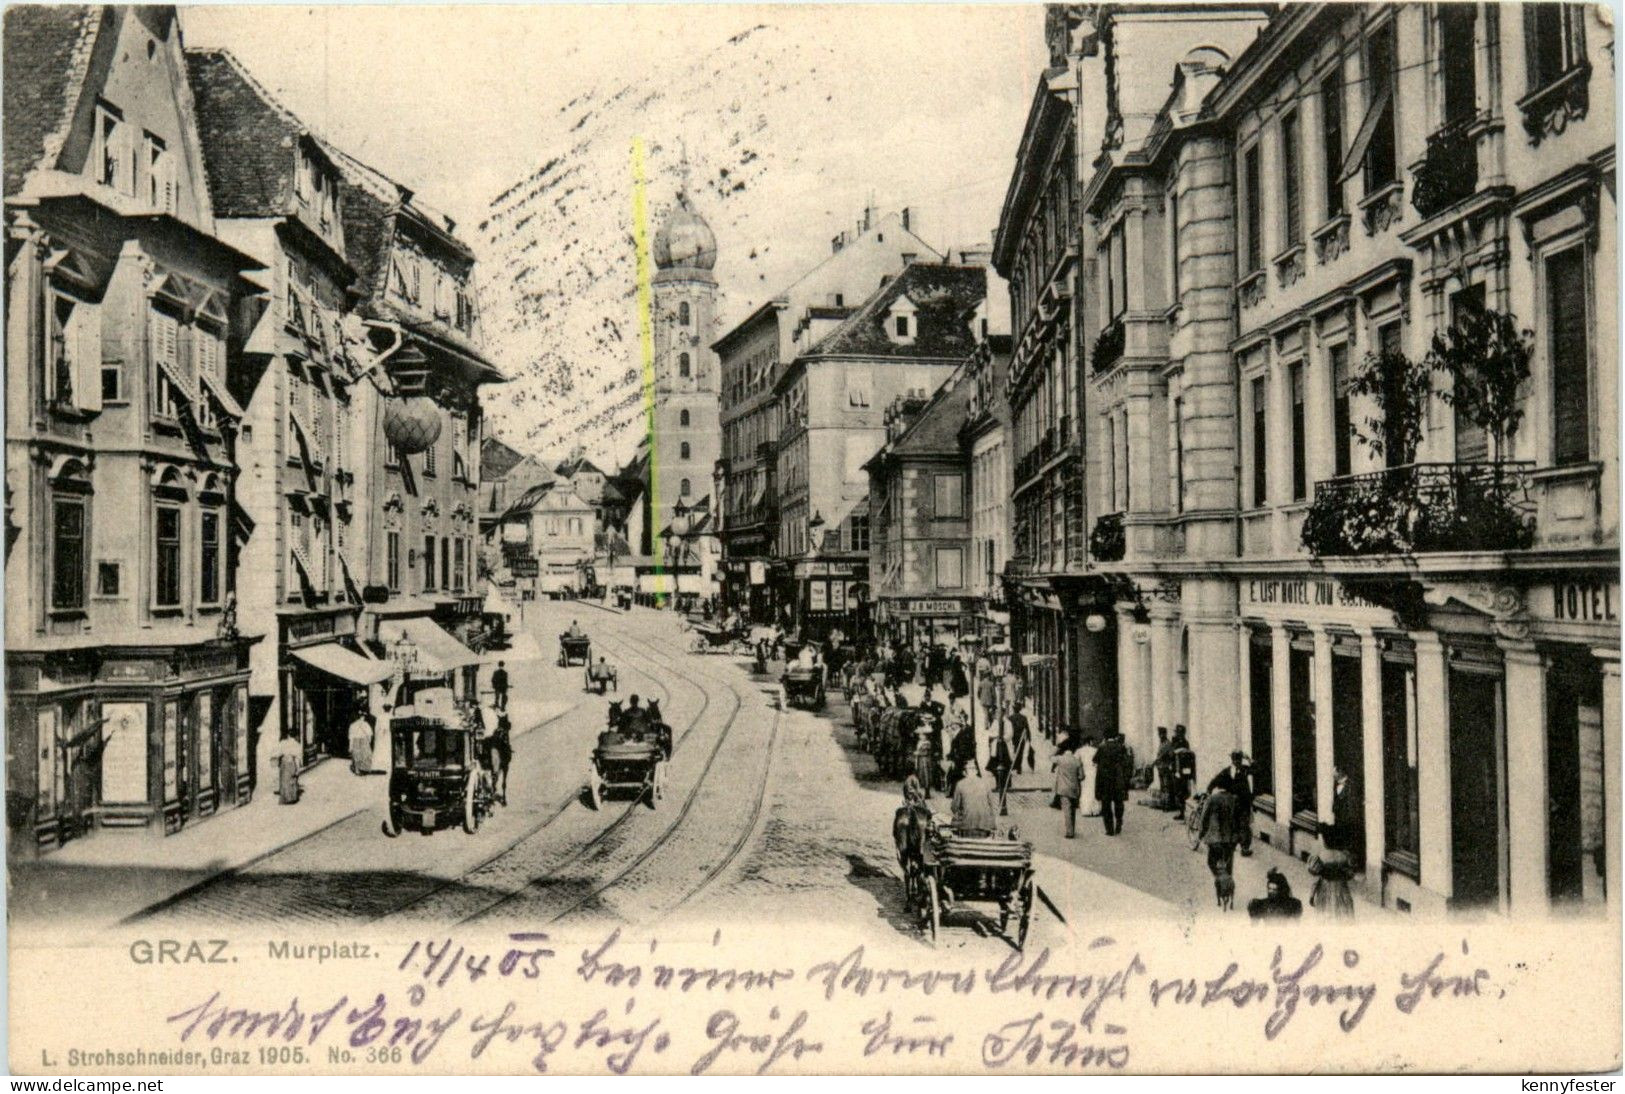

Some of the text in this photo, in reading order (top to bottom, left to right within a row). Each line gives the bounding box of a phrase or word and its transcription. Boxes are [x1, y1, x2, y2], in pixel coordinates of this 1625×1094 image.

[1281, 581, 1309, 605] HOTEL
[1314, 582, 1333, 606] ZUM
[1554, 583, 1616, 620] HOTEL
[129, 939, 379, 964] GRAZ. Murplatz.
[42, 1047, 403, 1068] L. Strohschneider, Graz 1905. No. 366
